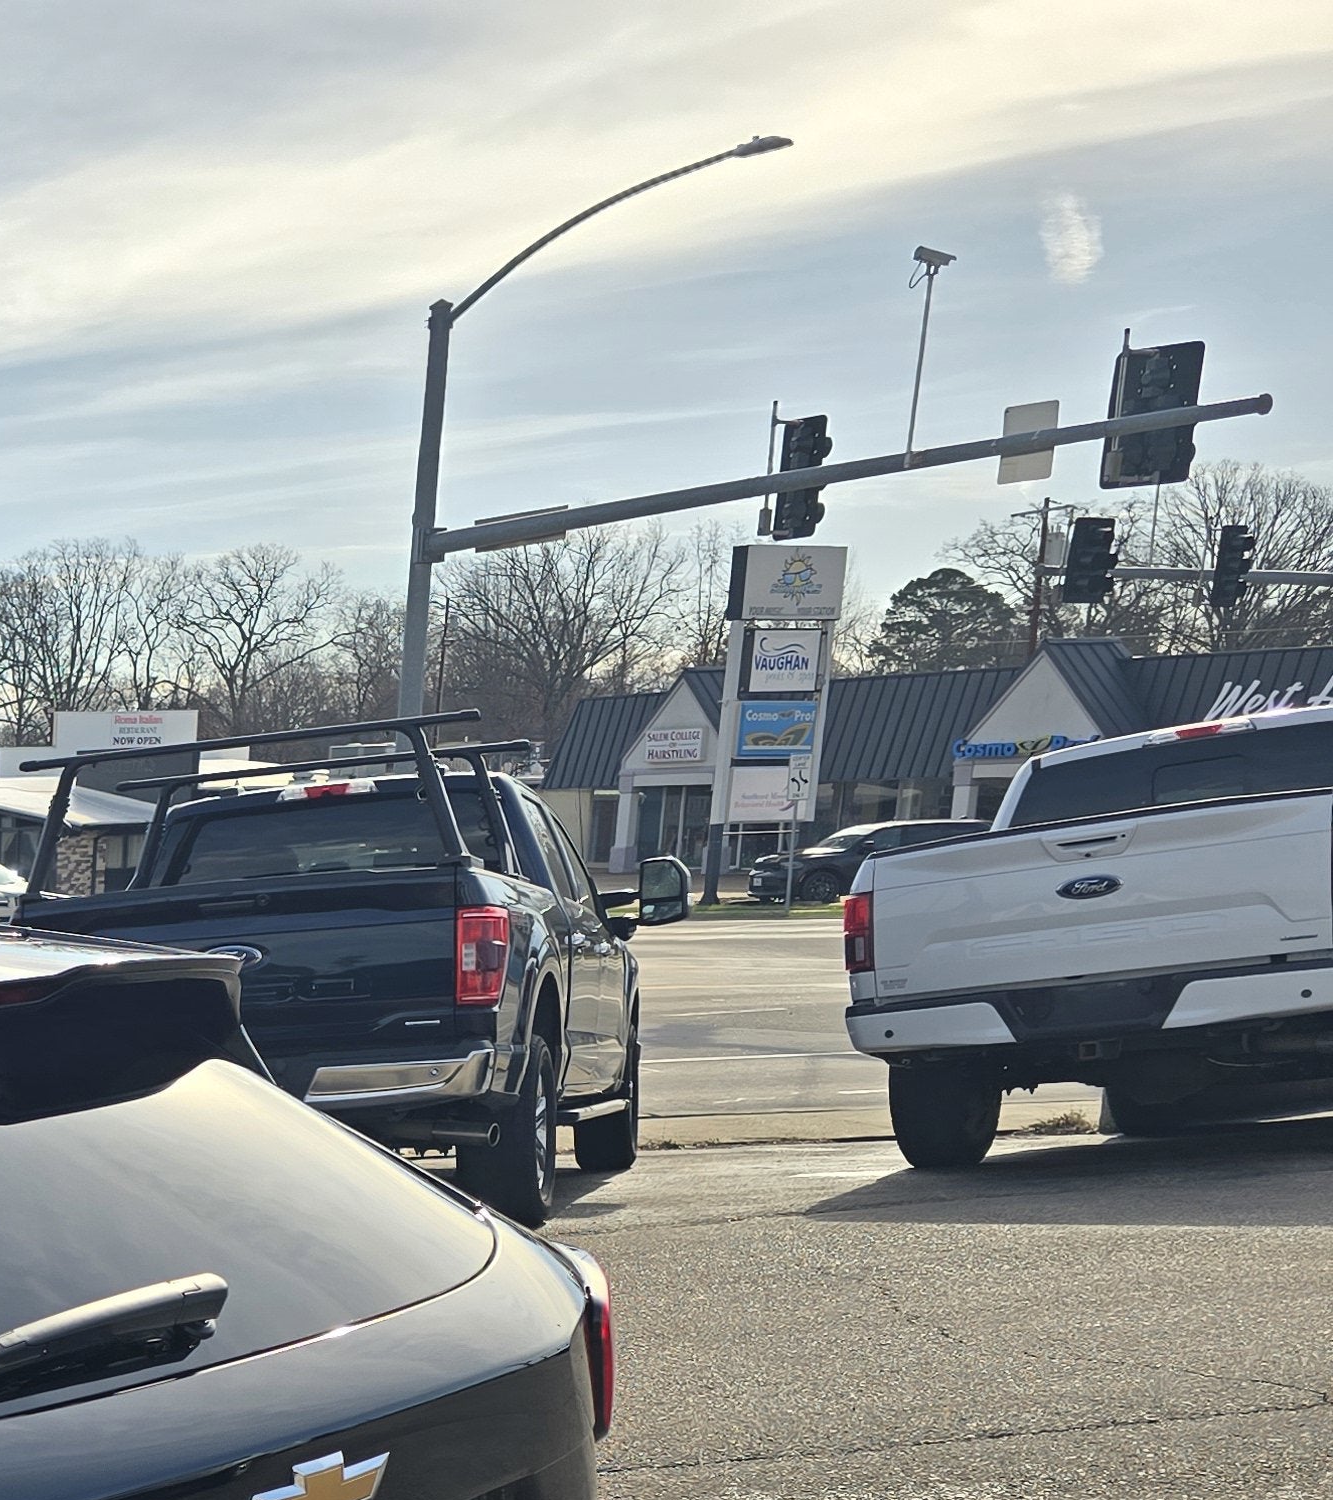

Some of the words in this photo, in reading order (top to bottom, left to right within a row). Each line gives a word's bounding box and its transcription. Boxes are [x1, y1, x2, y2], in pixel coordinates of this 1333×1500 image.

[754, 654, 809, 671] VAUGHAN
[1203, 679, 1305, 721] West
[746, 709, 779, 721] Cosmo
[113, 736, 135, 745] NOW
[137, 736, 162, 745] OPEN
[952, 737, 1018, 758] Cosmo
[1071, 879, 1109, 895] Ford
